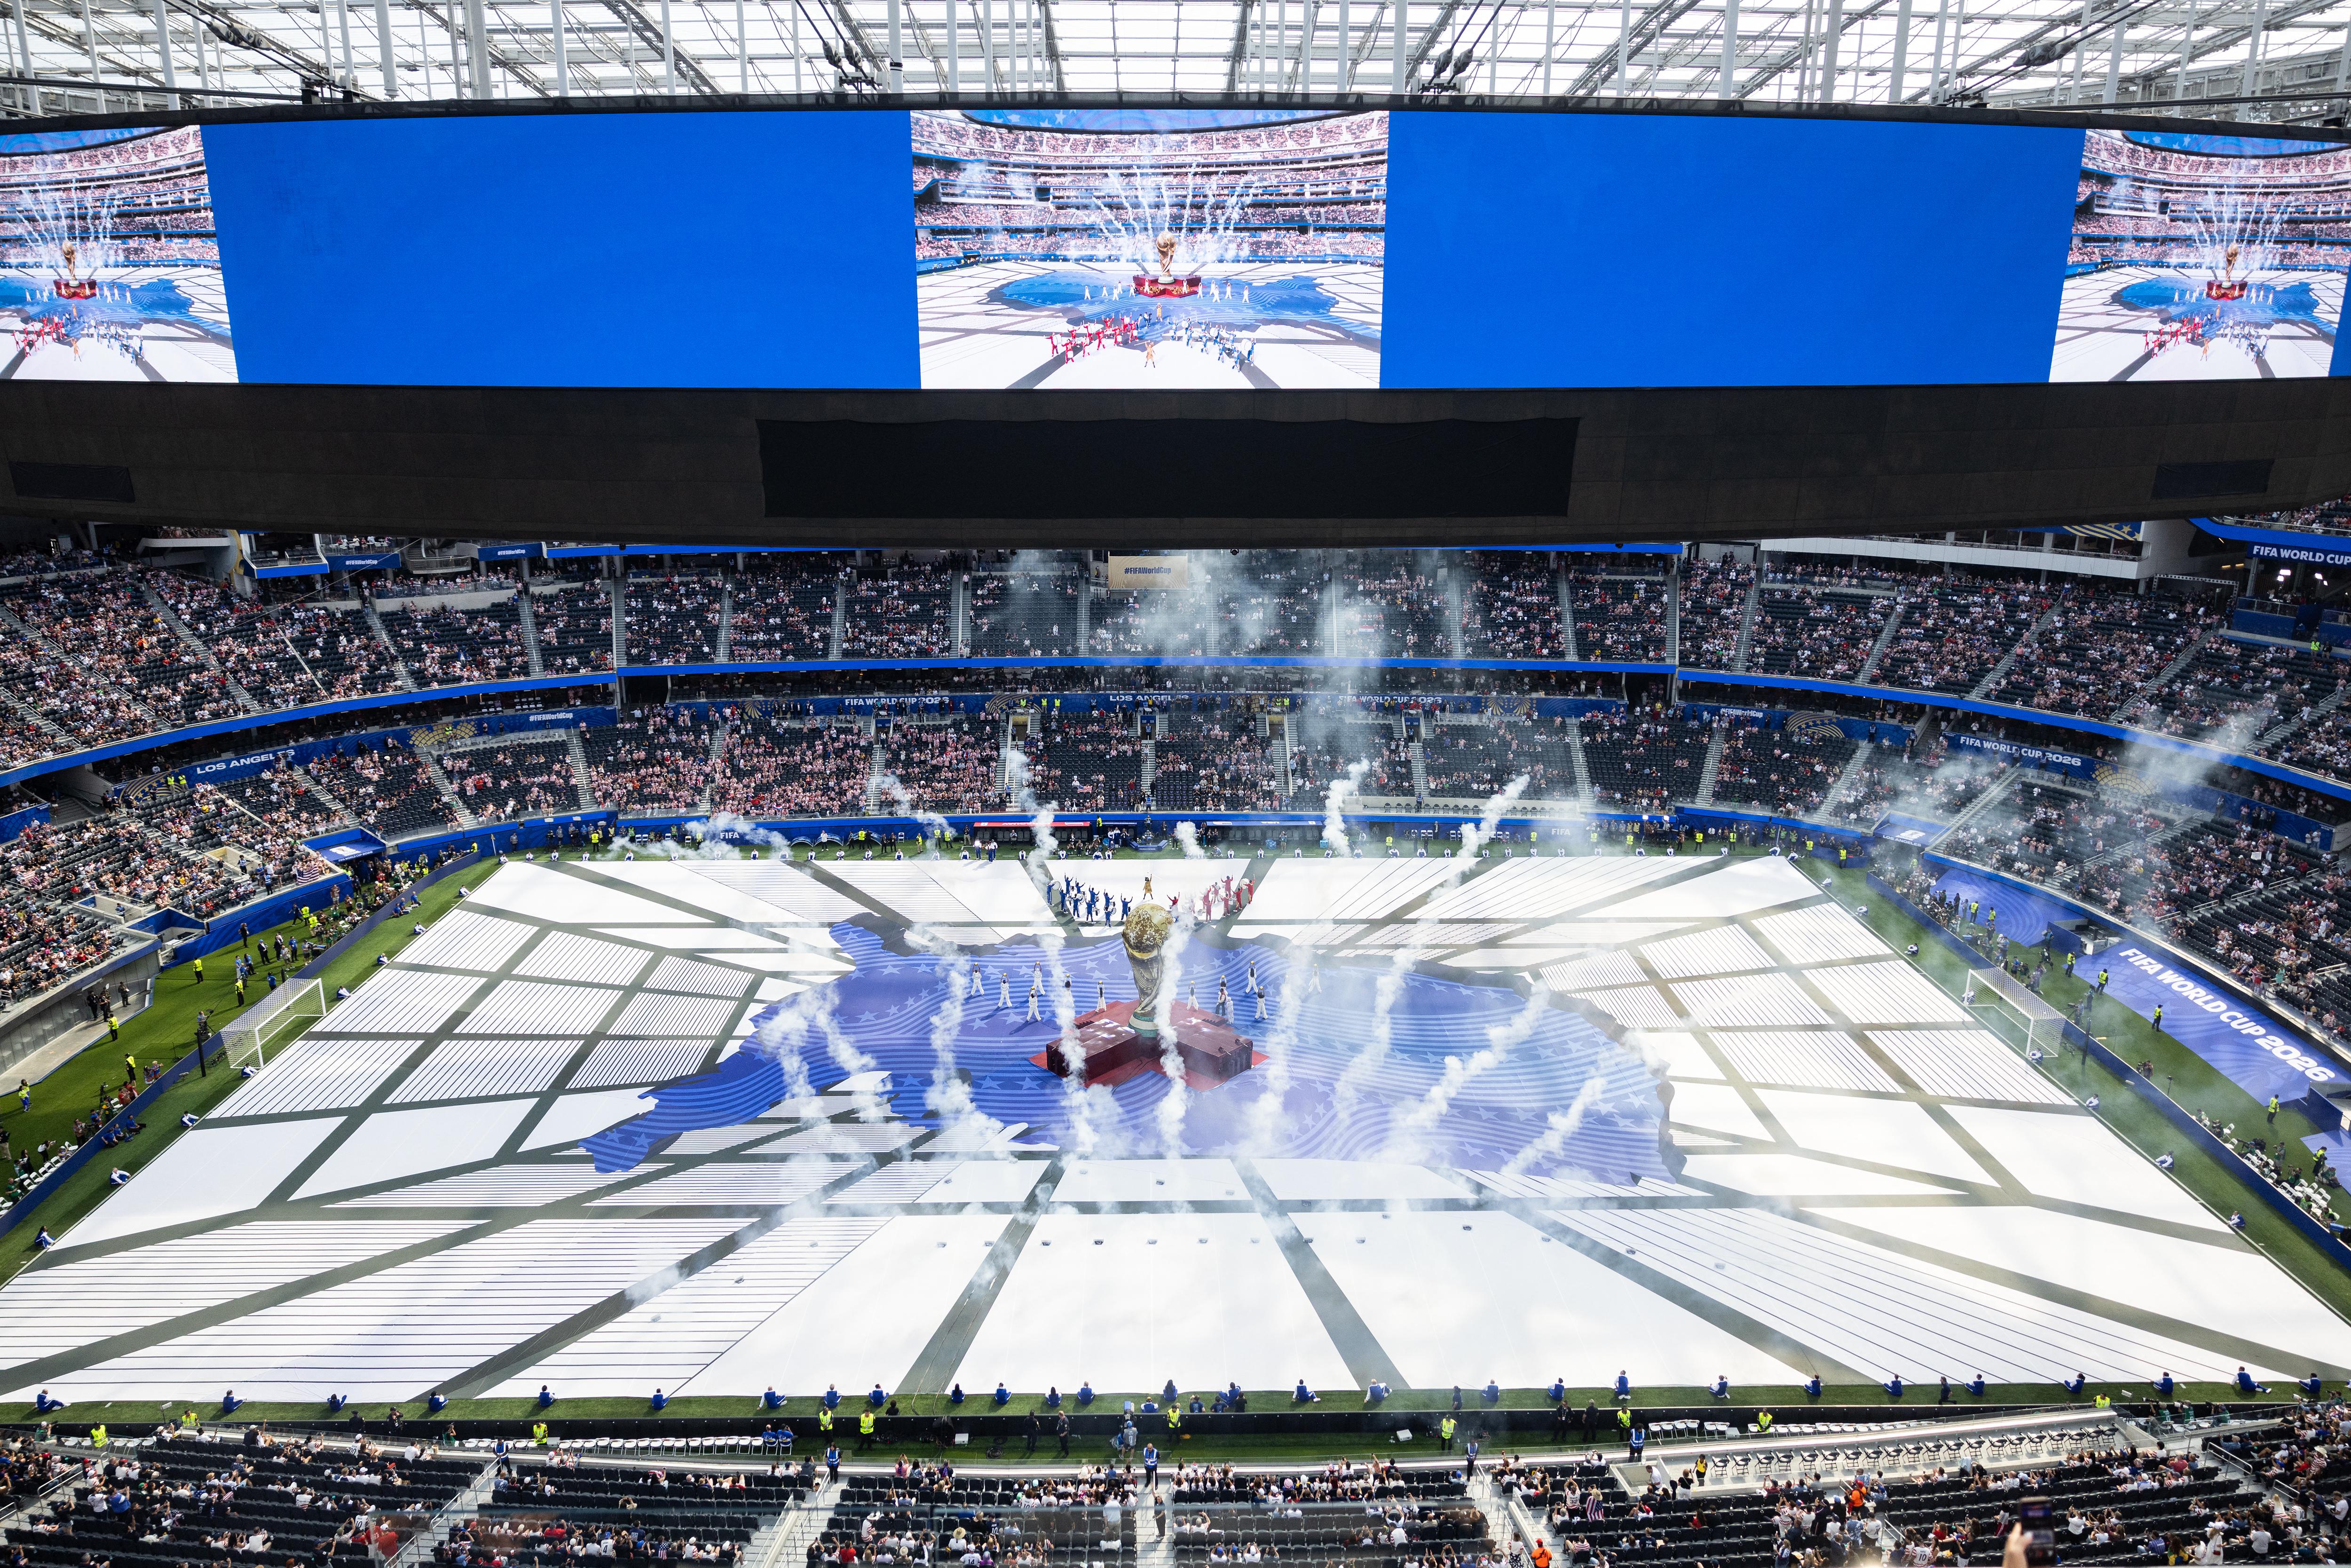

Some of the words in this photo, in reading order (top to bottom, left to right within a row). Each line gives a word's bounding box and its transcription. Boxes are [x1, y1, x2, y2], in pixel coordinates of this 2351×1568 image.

[2253, 545, 2278, 557] FIFA
[2280, 549, 2325, 562] WORLD
[2326, 554, 2351, 566] CUP
[529, 713, 573, 721] #FIFAWorldCup
[1960, 736, 1981, 747] FIFA
[1983, 741, 2020, 754] WORLD
[2021, 748, 2042, 758] CUP
[2045, 752, 2082, 766] 2026
[197, 763, 226, 774] LOS
[1895, 838, 1922, 847] ANGELES
[2119, 948, 2164, 975] FIFA
[2156, 970, 2227, 1013] WORLD
[2219, 1011, 2266, 1036] CUP
[2254, 1035, 2335, 1082] 2026
[603, 1545, 608, 1553] 4
